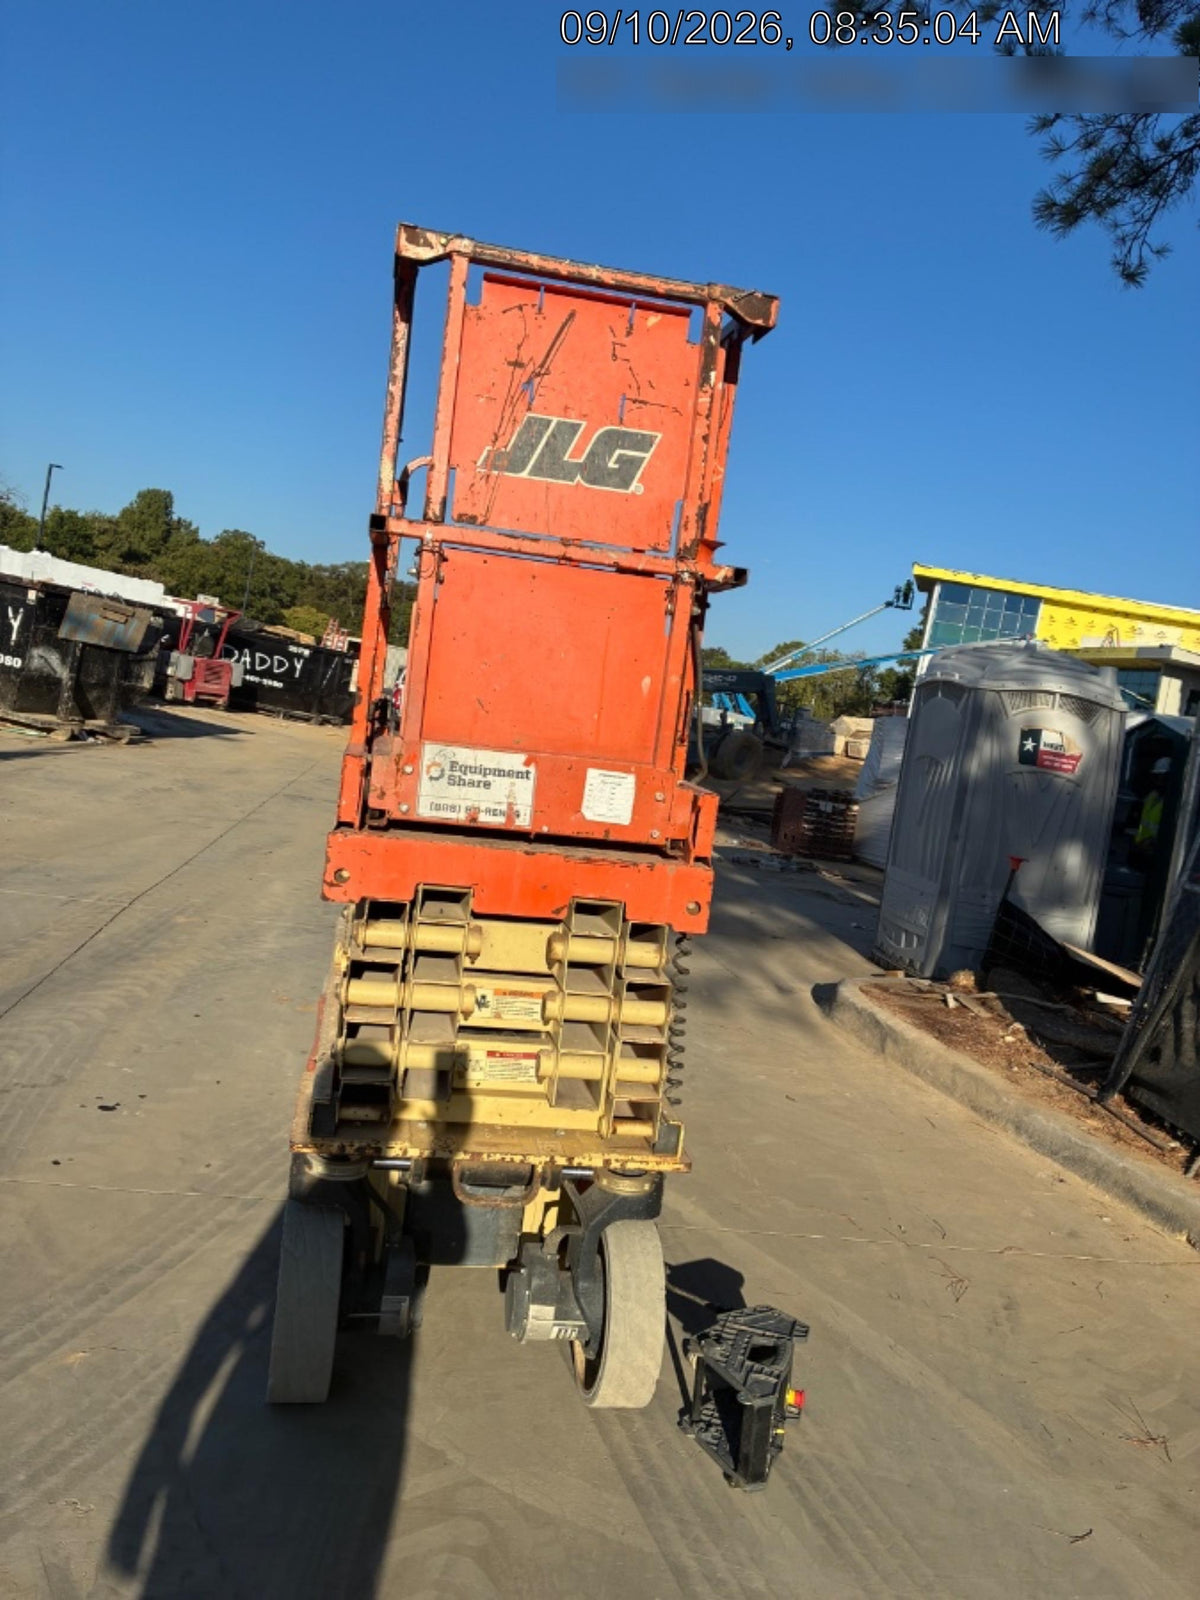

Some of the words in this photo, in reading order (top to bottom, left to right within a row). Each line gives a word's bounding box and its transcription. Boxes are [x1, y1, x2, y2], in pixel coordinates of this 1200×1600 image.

[477, 413, 662, 493] JLG
[448, 760, 532, 780] Equipment
[447, 774, 491, 790] Share
